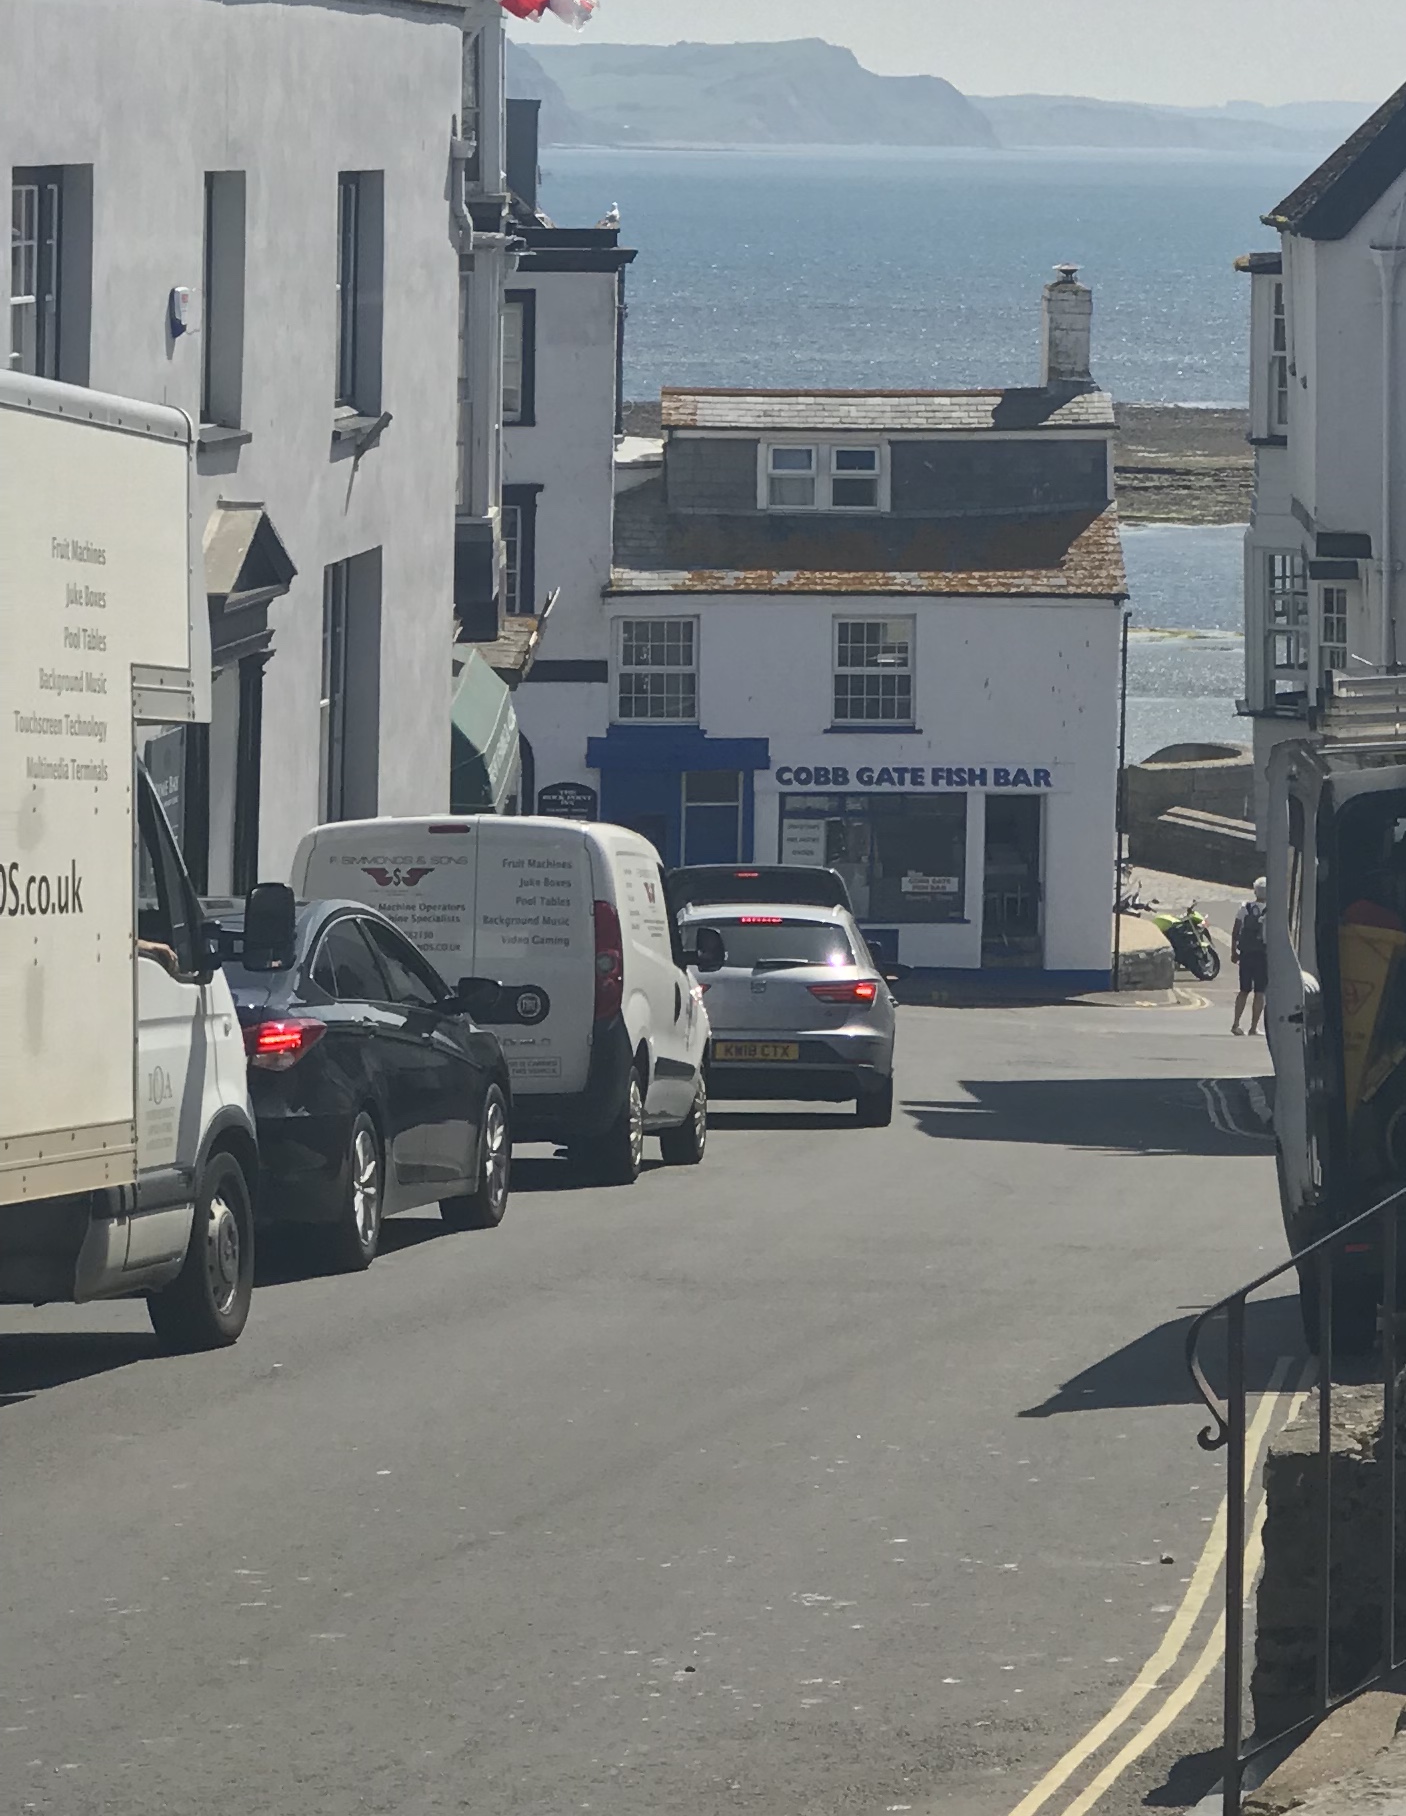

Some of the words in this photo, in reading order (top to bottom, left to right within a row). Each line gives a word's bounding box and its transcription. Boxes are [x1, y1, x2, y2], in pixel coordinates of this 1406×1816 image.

[51, 537, 70, 560] Fruit
[71, 539, 106, 566] Machines
[65, 583, 83, 608] Juke
[84, 585, 106, 609] Boxes
[64, 626, 81, 649] Pool
[82, 628, 107, 652] Tables
[39, 668, 83, 696] Background
[85, 672, 107, 695] Music
[13, 710, 63, 735] Touchscreen
[64, 714, 108, 743] Technology
[26, 756, 70, 780] Multimedia
[70, 758, 109, 782] Terminals
[775, 766, 850, 786] COBB
[856, 766, 925, 786] GATE
[931, 767, 988, 787] FISH
[993, 767, 1053, 788] BAR
[430, 855, 469, 865] SONS
[502, 858, 525, 869] Fruit
[527, 858, 573, 869] Machines
[519, 877, 541, 889] Juke
[544, 877, 572, 888] Boxes
[378, 903, 417, 912] Machine
[418, 903, 467, 913] Operators
[515, 896, 537, 906] Pool
[540, 896, 571, 907] Tables
[412, 914, 461, 924] Specialists
[482, 915, 540, 928] Background
[542, 916, 570, 927] Music
[532, 935, 570, 947] Gaming
[761, 1044, 790, 1058] CTX
